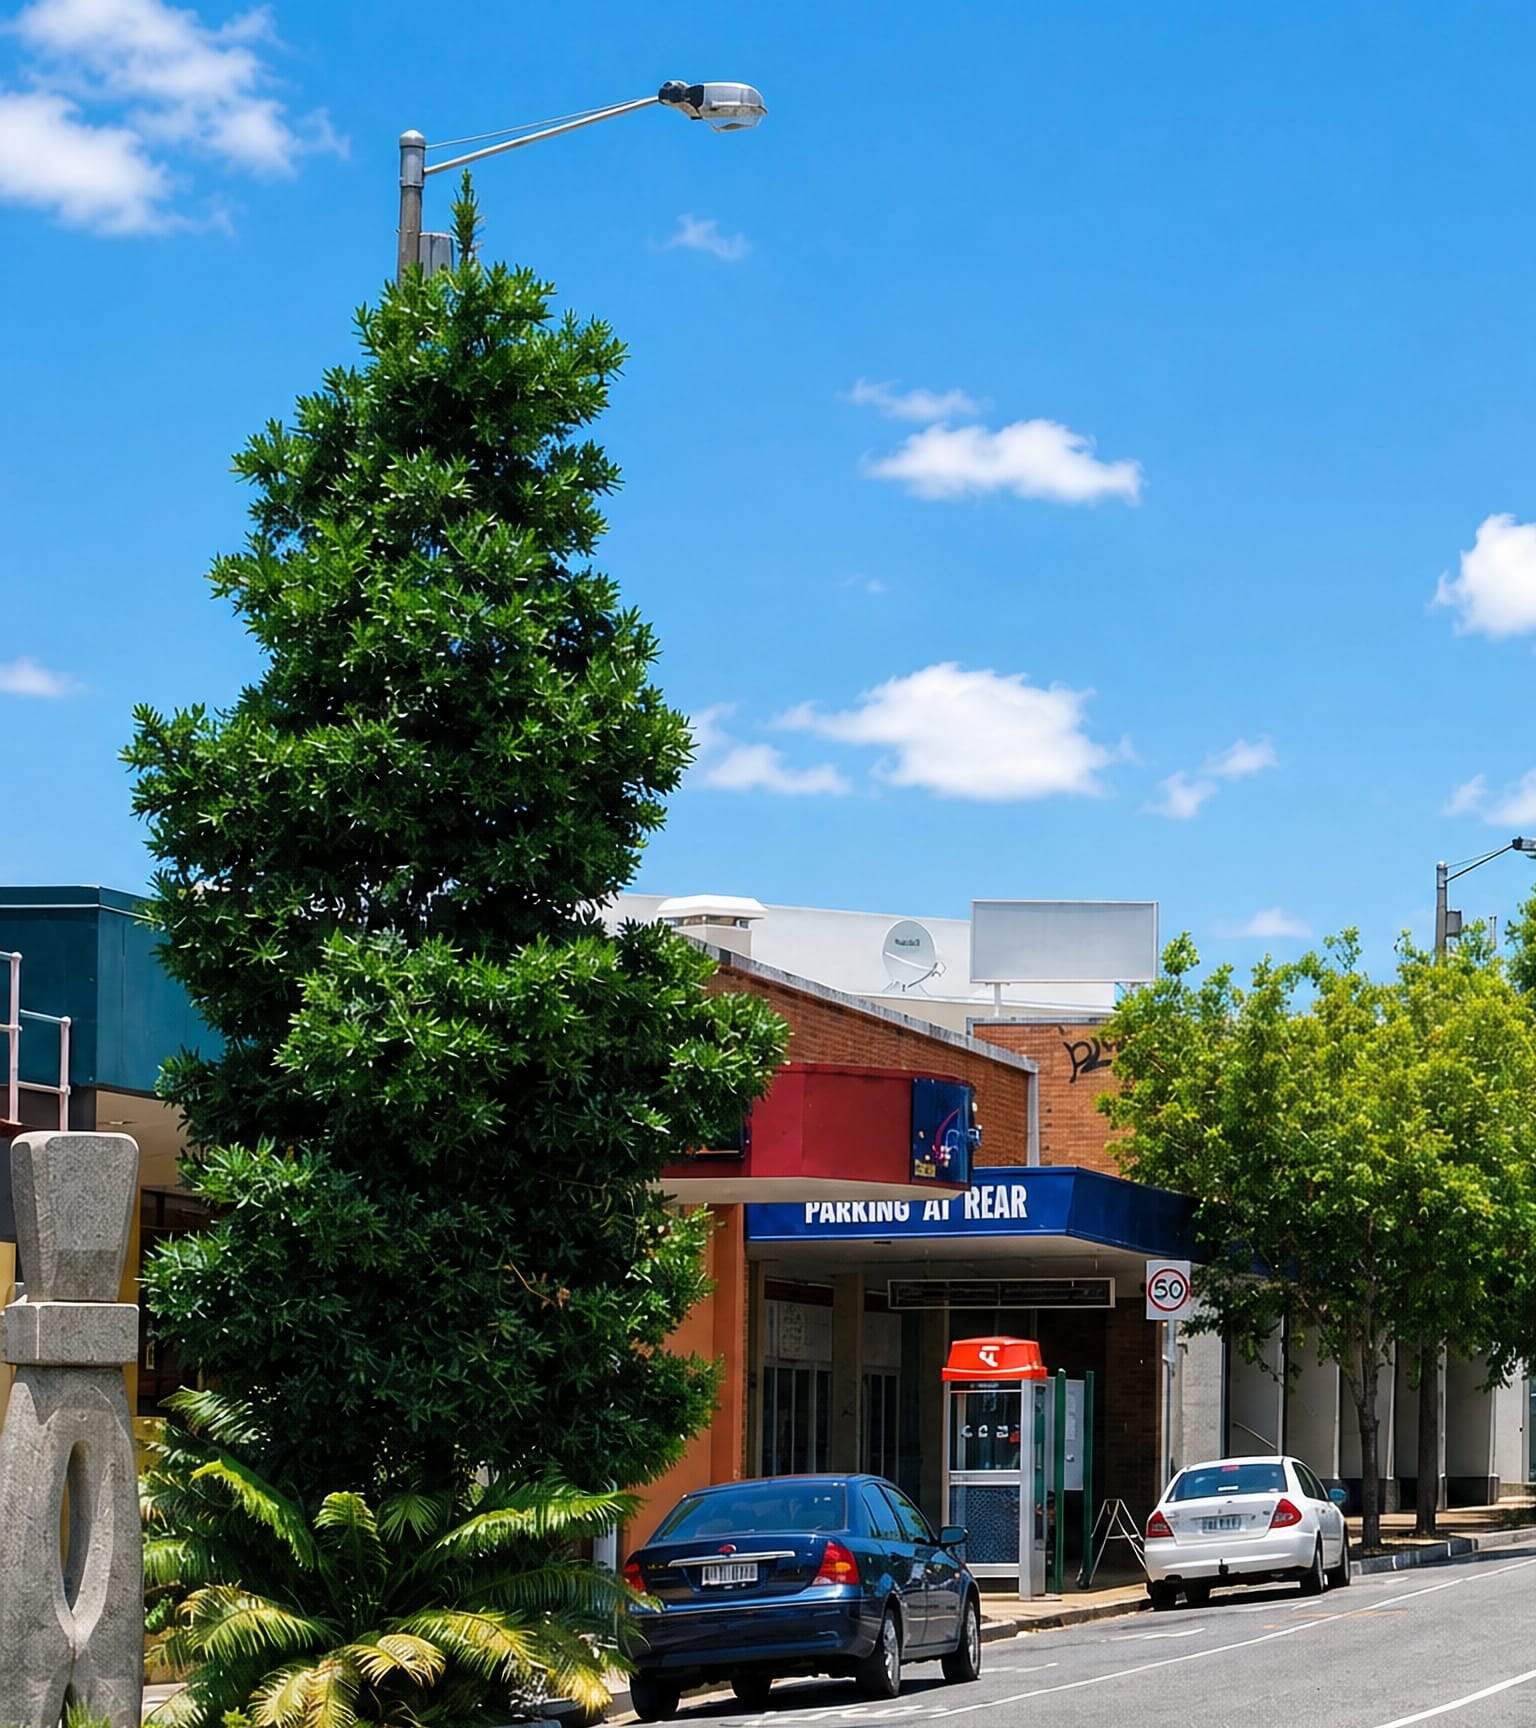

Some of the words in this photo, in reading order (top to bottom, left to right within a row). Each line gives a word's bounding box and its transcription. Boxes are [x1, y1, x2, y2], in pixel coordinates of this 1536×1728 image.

[805, 1201, 910, 1223] PARKING
[964, 1185, 1028, 1219] REAR
[1154, 1279, 1183, 1299] 50
